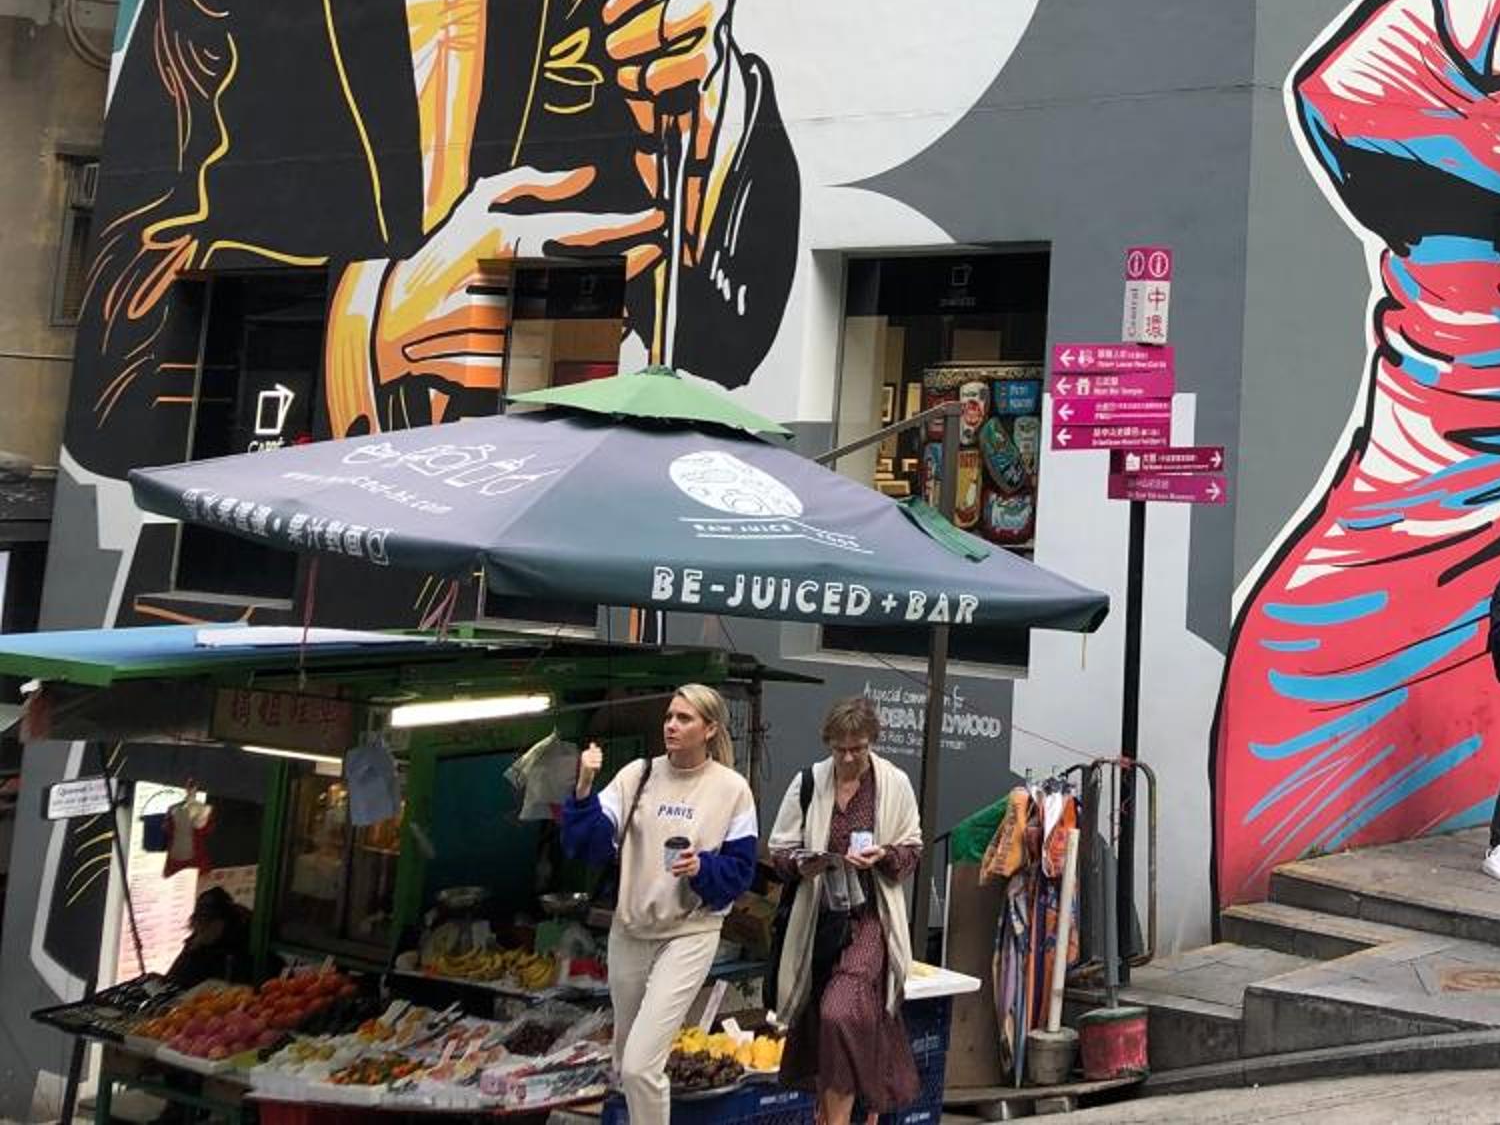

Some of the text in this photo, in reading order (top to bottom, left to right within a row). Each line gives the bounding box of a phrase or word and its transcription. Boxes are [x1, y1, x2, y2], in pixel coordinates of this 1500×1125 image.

[651, 566, 872, 616] BE-JUICED
[905, 590, 978, 624] BAR
[657, 803, 694, 820] PARIS
